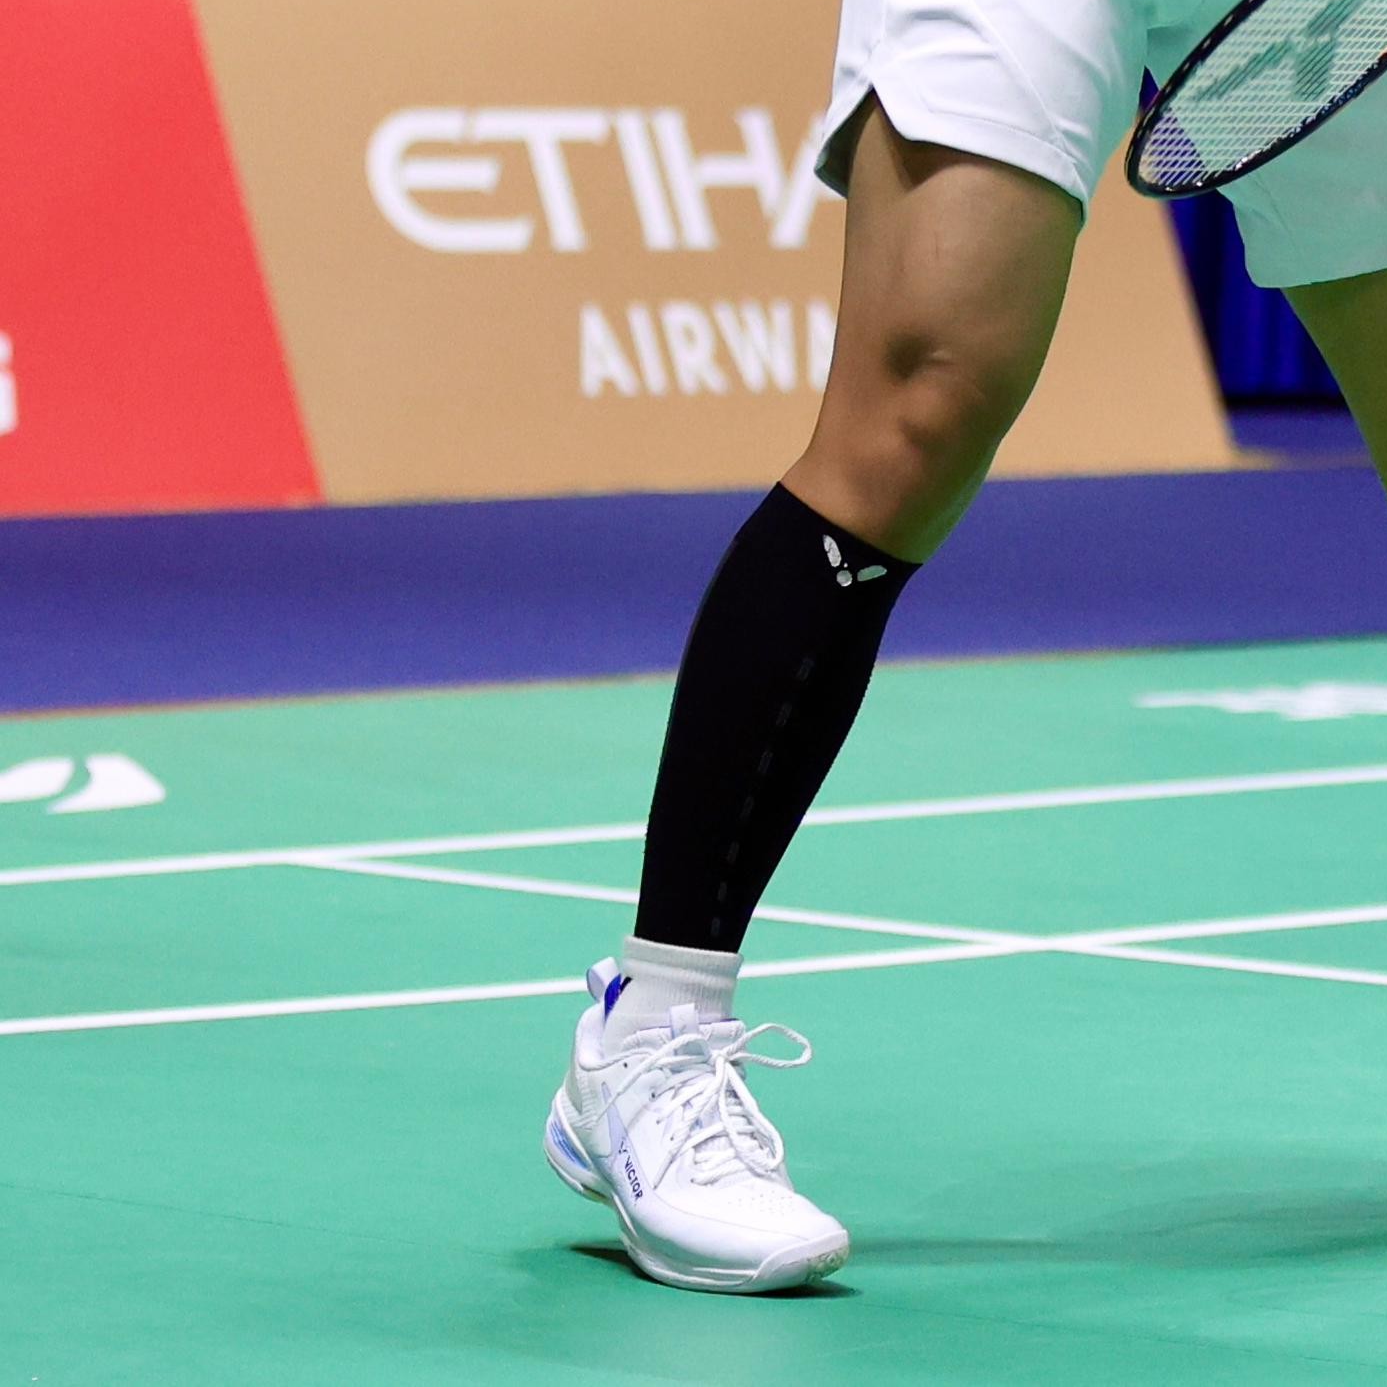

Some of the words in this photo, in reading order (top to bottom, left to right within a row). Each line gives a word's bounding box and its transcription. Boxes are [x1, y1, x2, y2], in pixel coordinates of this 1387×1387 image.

[366, 107, 848, 252] ETIH
[579, 301, 838, 398] AIRW
[624, 1154, 644, 1203] VICTOR
